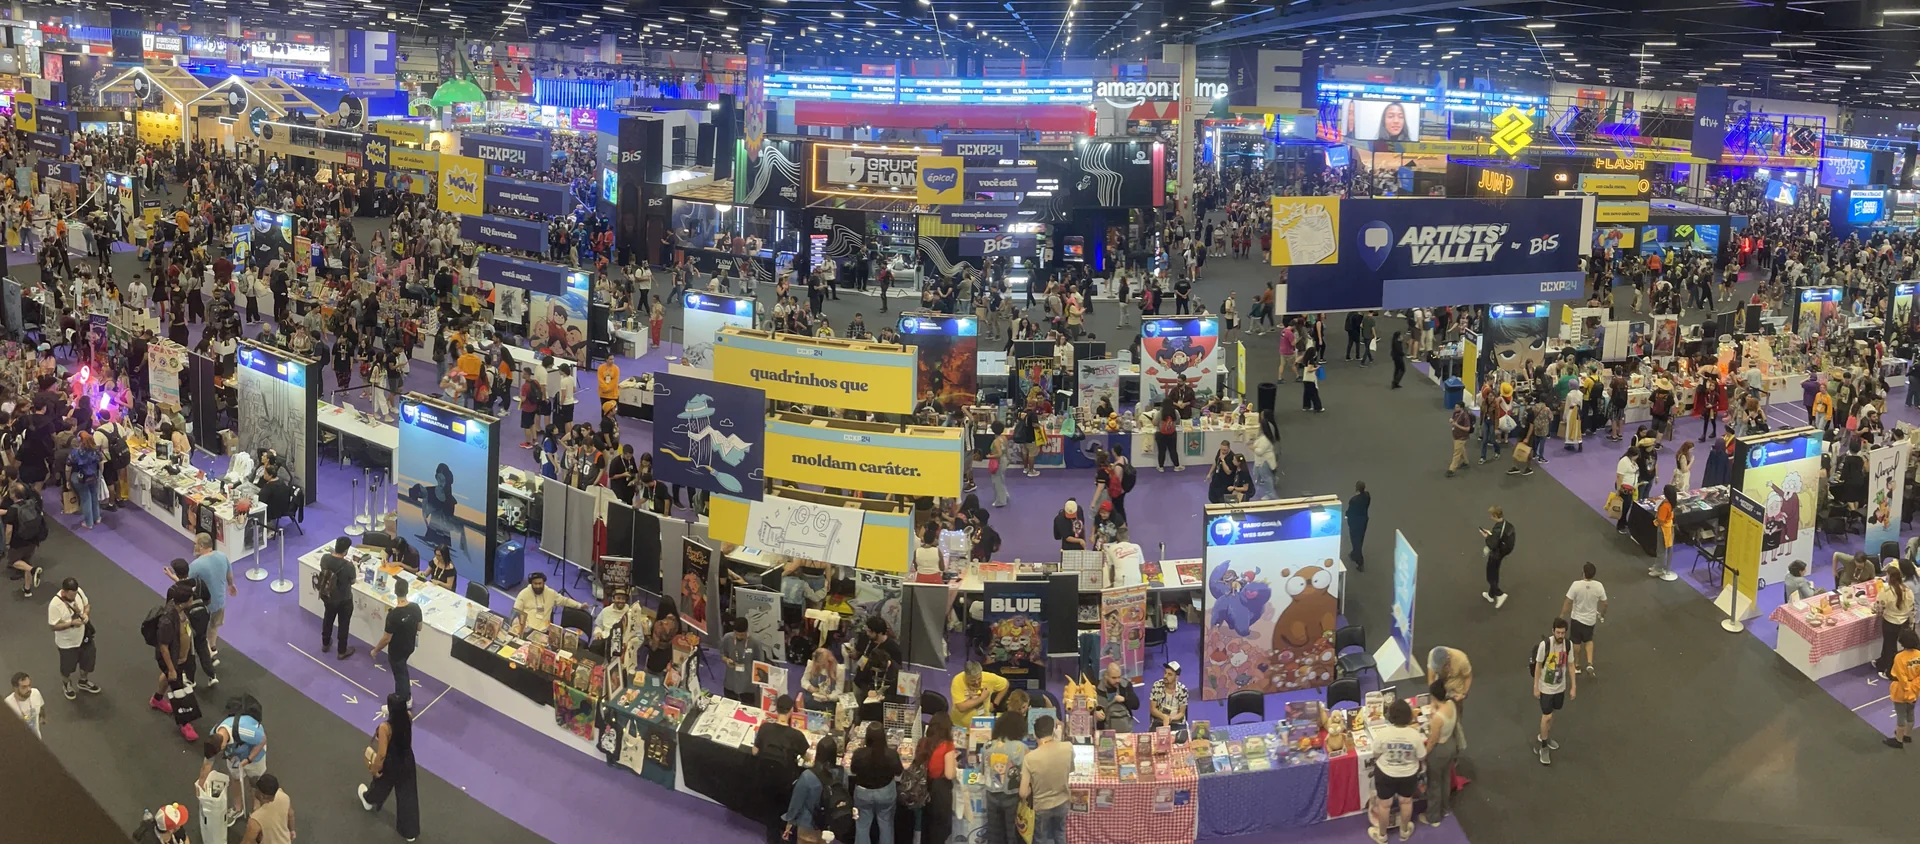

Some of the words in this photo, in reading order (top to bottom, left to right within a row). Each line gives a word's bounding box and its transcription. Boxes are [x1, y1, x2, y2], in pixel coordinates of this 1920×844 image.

[1256, 50, 1303, 107] E
[1096, 81, 1168, 97] amazon
[1173, 79, 1229, 100] pime
[478, 145, 526, 164] CCXP24
[957, 145, 1003, 155] CCXP24
[1460, 143, 1475, 151] VISA
[621, 150, 642, 163] BiS
[1836, 166, 1857, 175] 2024
[448, 173, 474, 193] WOW
[866, 171, 918, 186] FLOW
[927, 173, 954, 184] épico!
[1000, 178, 1018, 187] está
[1478, 169, 1514, 195] JUMP
[511, 192, 539, 202] próxima
[480, 227, 491, 235] HQ
[491, 228, 517, 239] favorita
[1399, 224, 1508, 246] ARTISTS'
[983, 236, 1013, 253] BiS
[1411, 243, 1501, 265] VALLEY
[1511, 241, 1521, 250] by
[1528, 233, 1560, 255] BiS
[516, 273, 532, 281] aqui.
[1540, 281, 1577, 292] CCXP24
[749, 368, 838, 389] quadrinhos
[839, 379, 869, 393] que
[791, 452, 857, 471] moldam
[858, 461, 922, 477] caráter.
[990, 598, 1042, 614] BLUE
